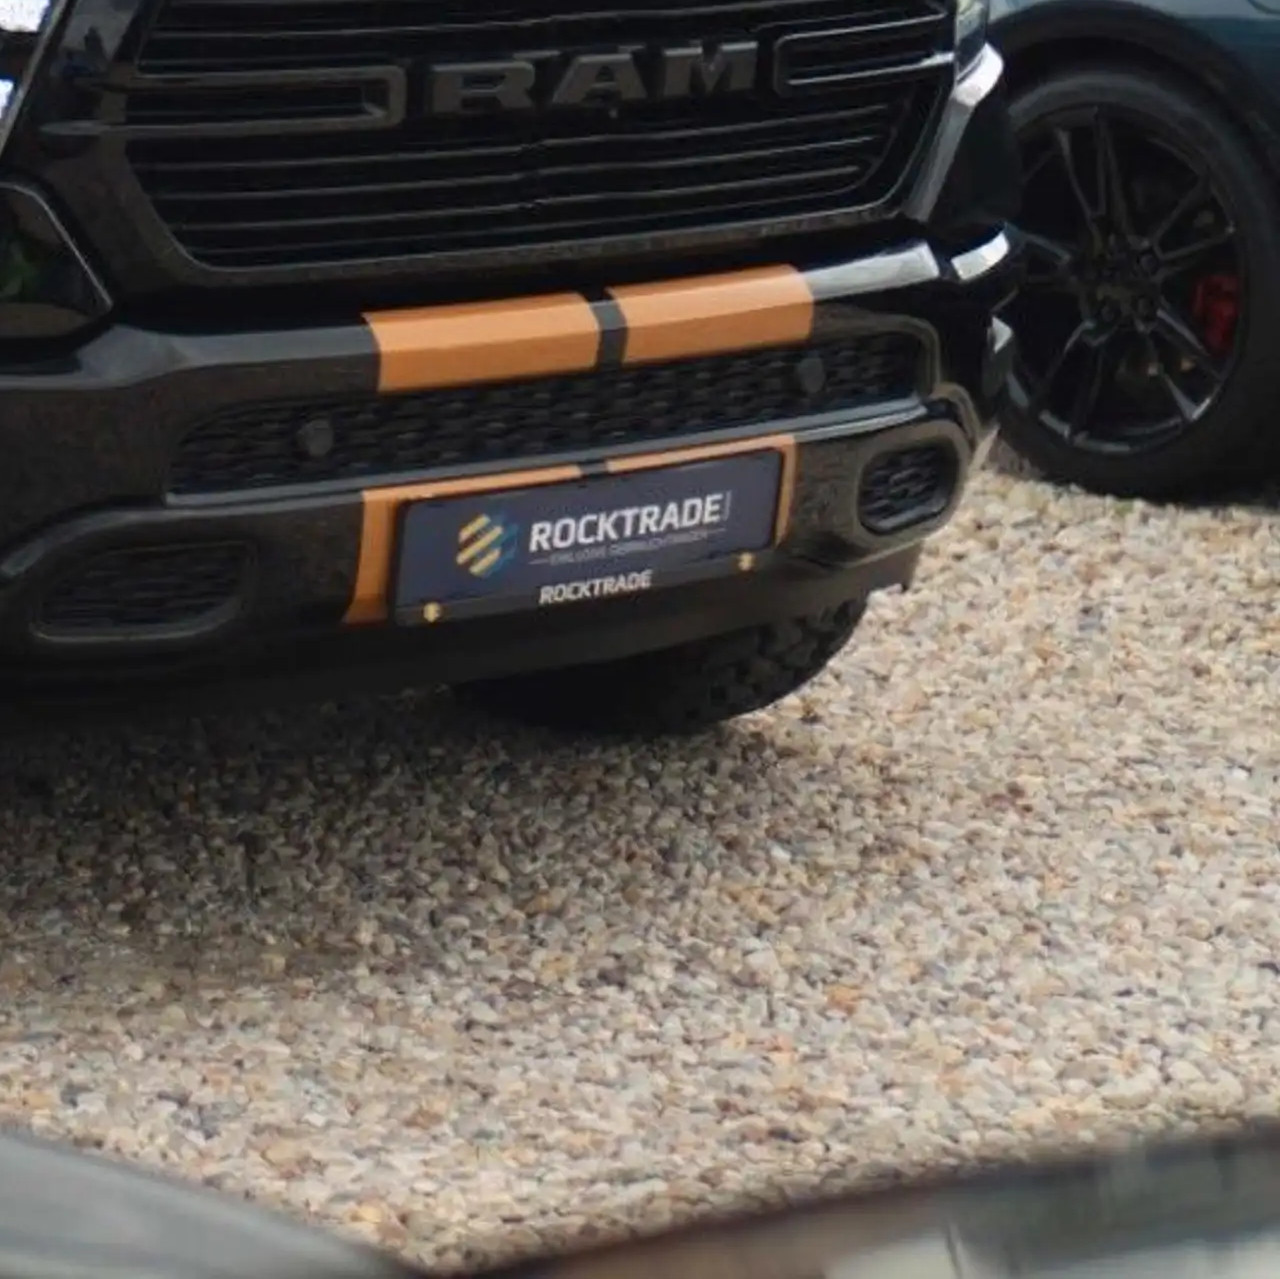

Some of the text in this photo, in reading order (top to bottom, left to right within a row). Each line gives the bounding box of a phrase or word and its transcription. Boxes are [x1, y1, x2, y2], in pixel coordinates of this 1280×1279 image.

[430, 40, 759, 116] RAM
[529, 493, 724, 553] ROCKTRADE
[539, 569, 654, 605] ROCKTRADE
